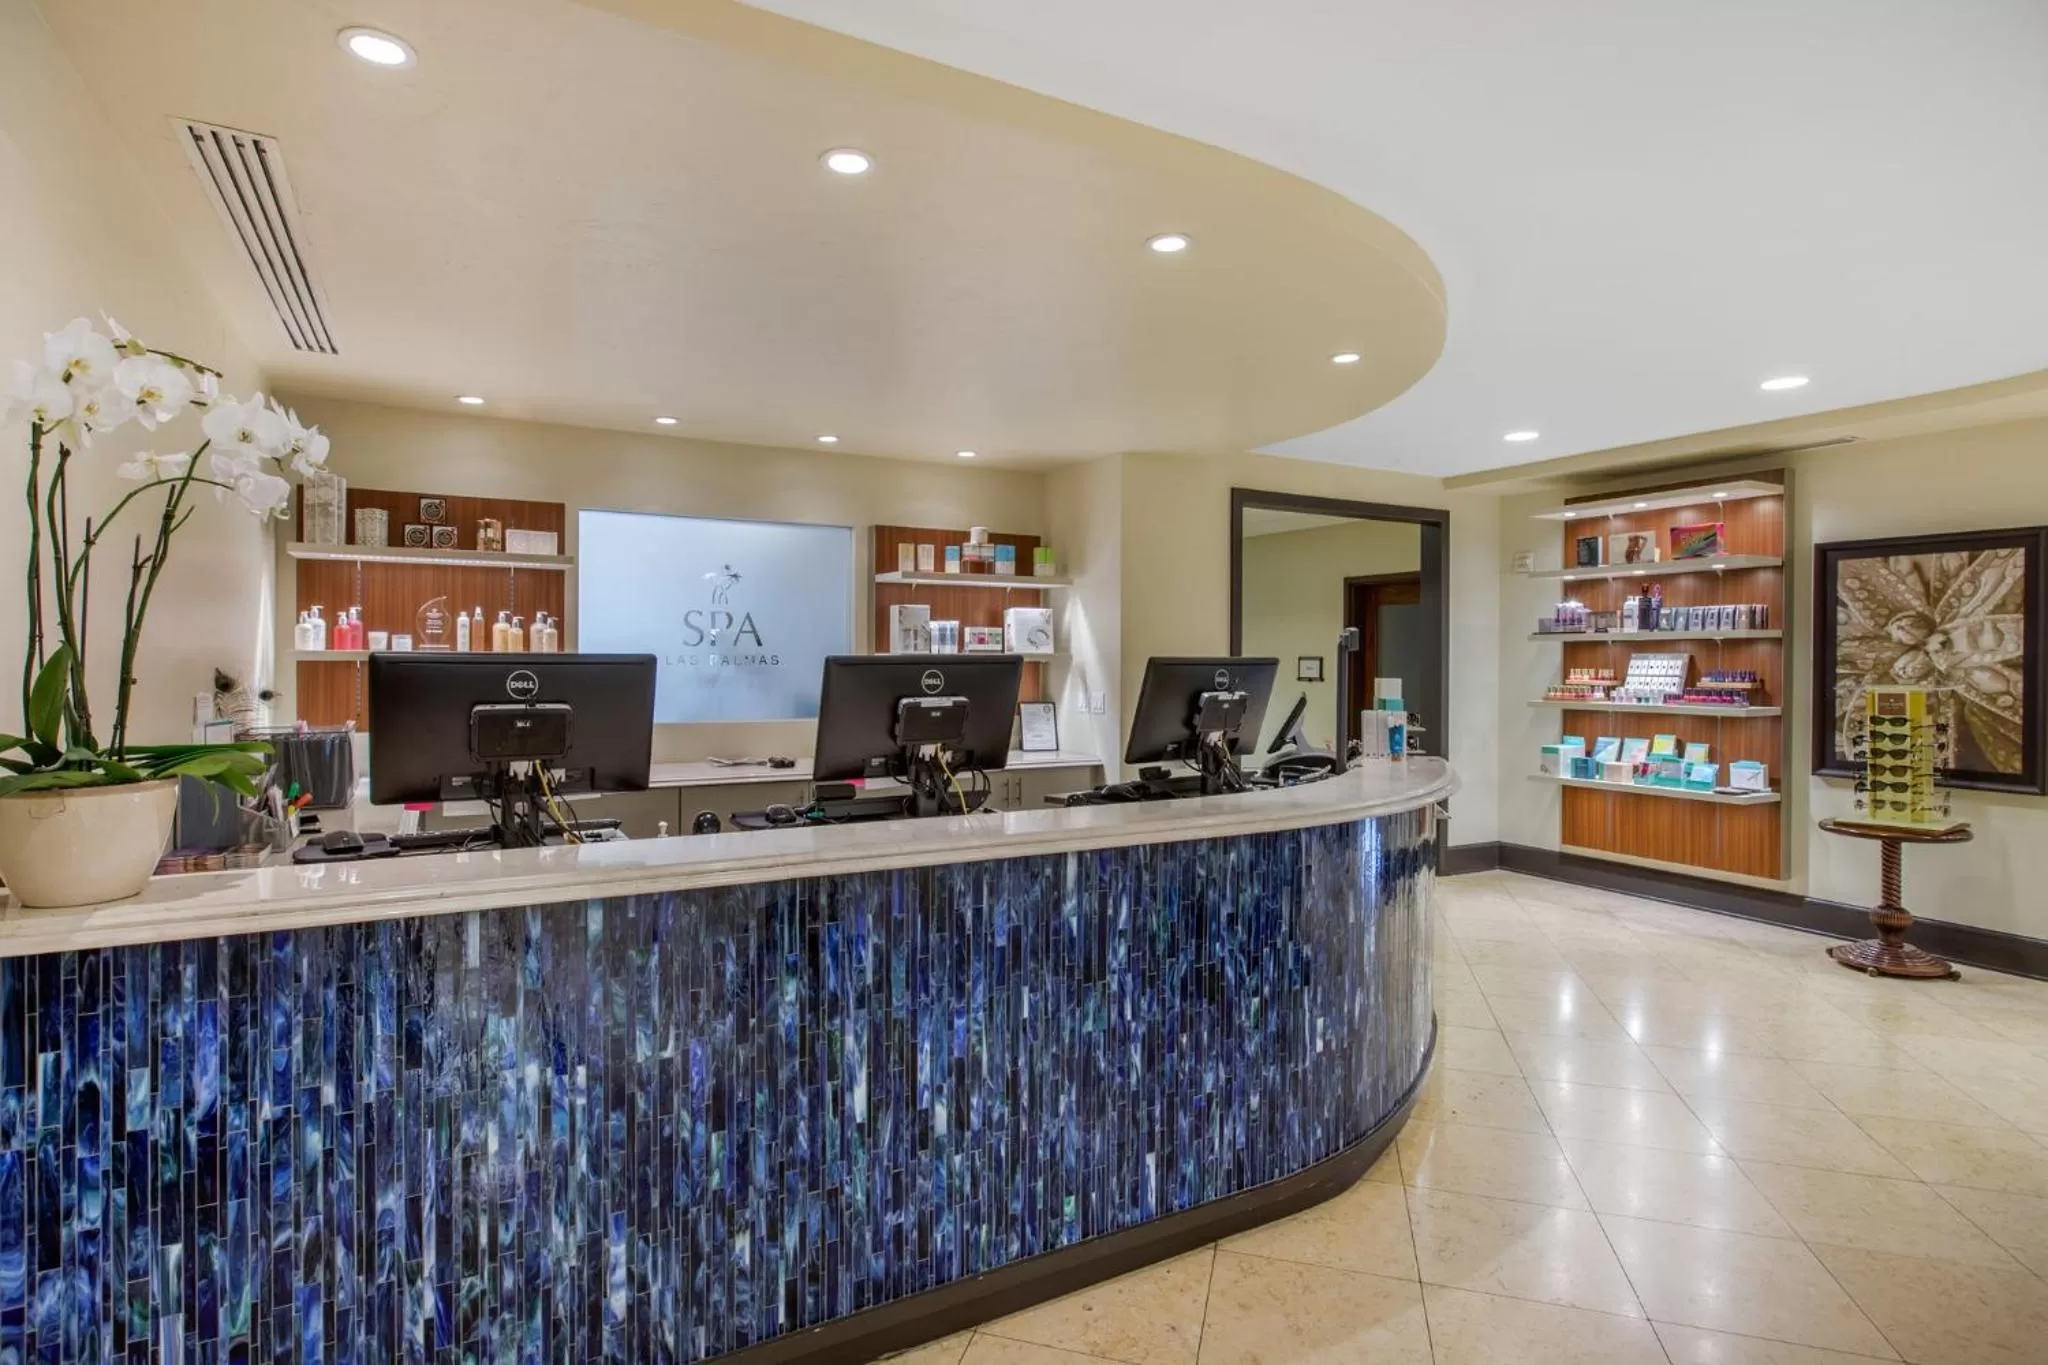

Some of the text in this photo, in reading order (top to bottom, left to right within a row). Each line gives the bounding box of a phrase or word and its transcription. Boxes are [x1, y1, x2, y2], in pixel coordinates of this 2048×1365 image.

[683, 610, 763, 647] SPA
[665, 655, 699, 666] LAS
[510, 680, 535, 689] DELL
